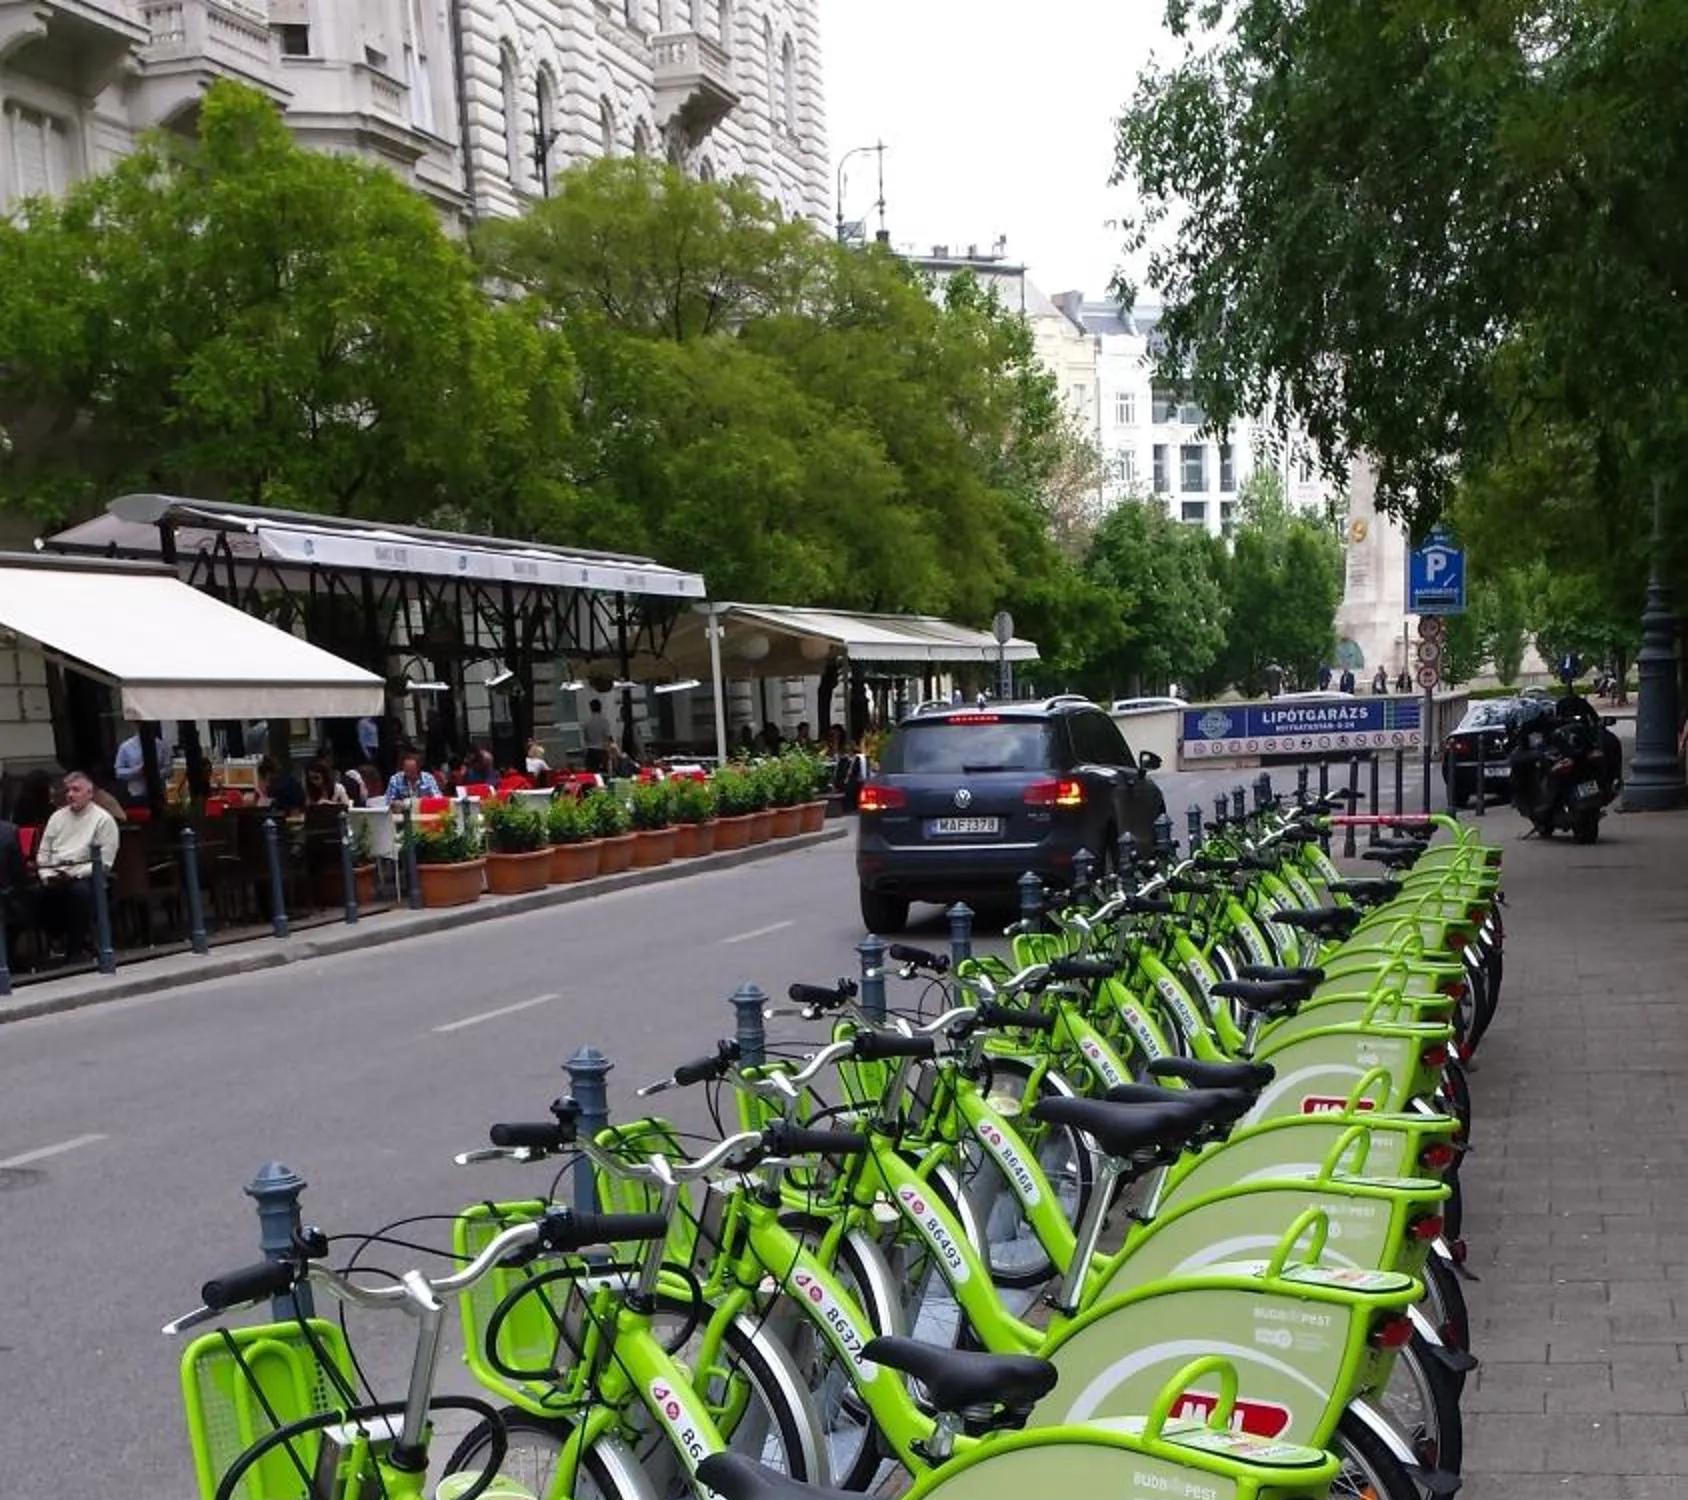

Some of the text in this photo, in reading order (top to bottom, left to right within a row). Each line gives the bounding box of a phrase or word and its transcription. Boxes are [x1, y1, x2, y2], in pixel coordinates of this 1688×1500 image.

[1426, 552, 1447, 581] P
[1262, 706, 1369, 724] LIPÓTGARÁZS
[926, 1217, 961, 1269] 86493
